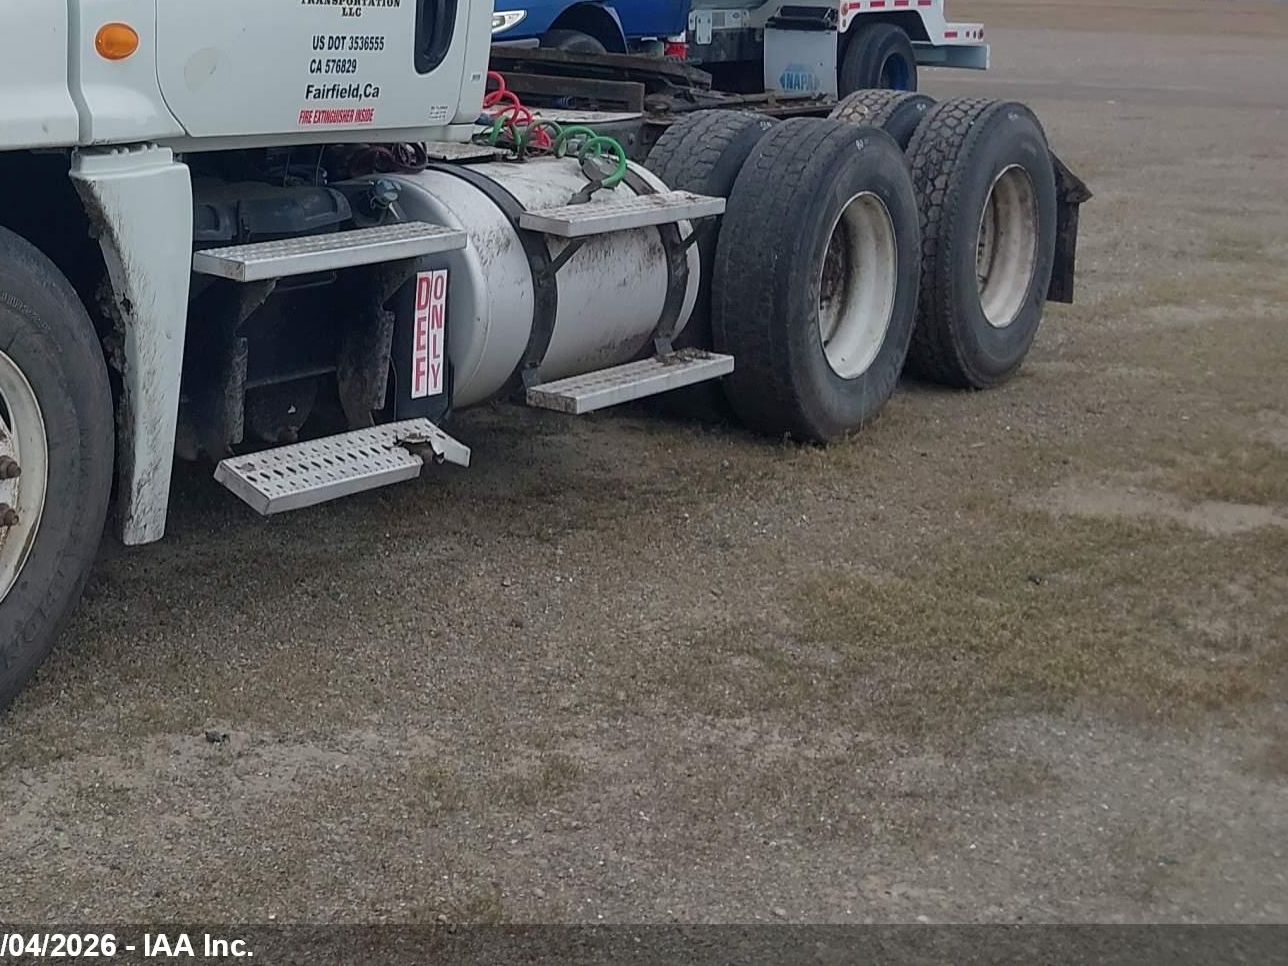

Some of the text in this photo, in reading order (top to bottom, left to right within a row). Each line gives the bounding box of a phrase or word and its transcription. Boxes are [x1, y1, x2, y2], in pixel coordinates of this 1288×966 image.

[342, 7, 362, 17] LLC
[312, 35, 385, 51] US DOT 3536555
[309, 58, 357, 74] CA 576829
[305, 83, 380, 102] Fairfield,Ca
[298, 108, 375, 124] FIRE EXTINGUISHER INSIDE
[415, 276, 431, 392] DEF
[431, 274, 445, 389] ONLY
